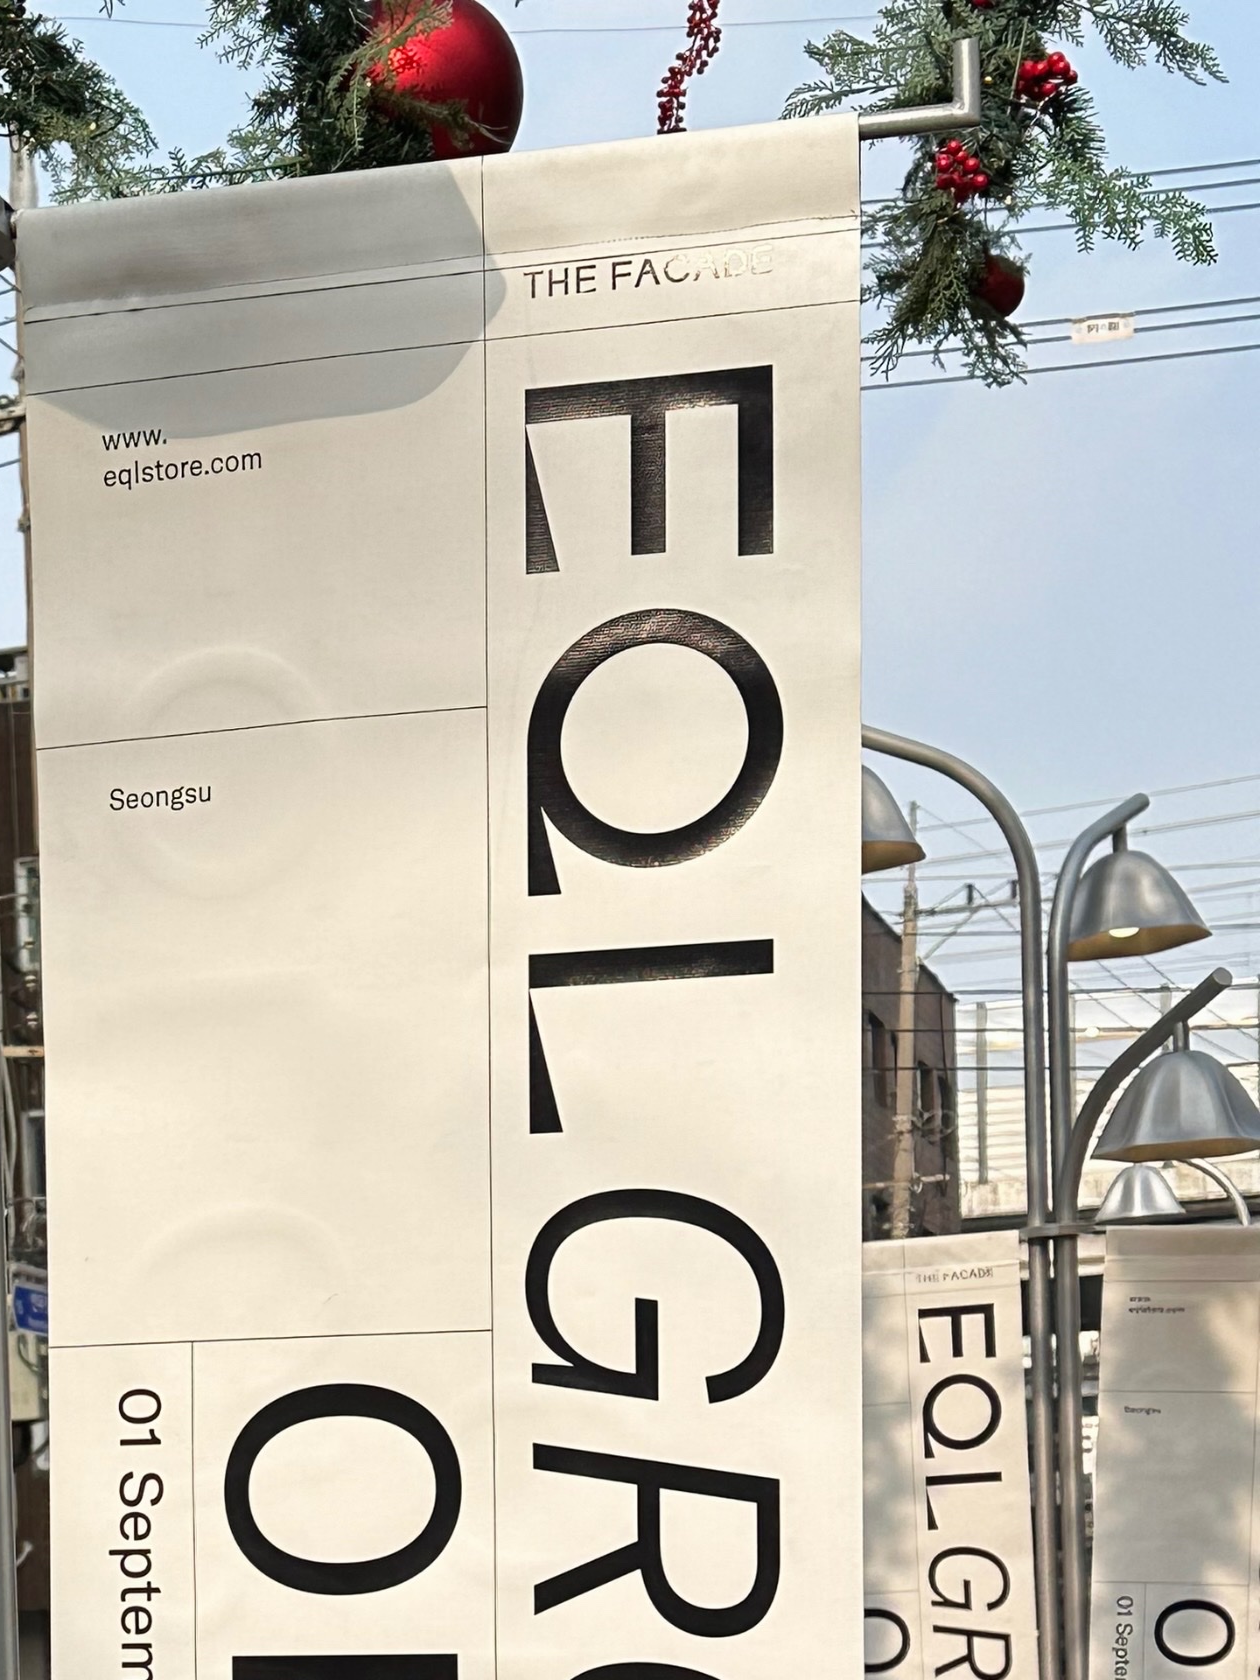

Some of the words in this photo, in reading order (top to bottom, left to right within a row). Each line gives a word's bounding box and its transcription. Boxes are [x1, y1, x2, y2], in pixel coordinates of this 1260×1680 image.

[523, 264, 597, 299] THE
[101, 427, 169, 452] www.
[103, 450, 263, 491] eqlstore.com
[109, 784, 212, 812] Seongsu
[118, 1388, 162, 1447] 01
[1116, 1595, 1134, 1617] 01
